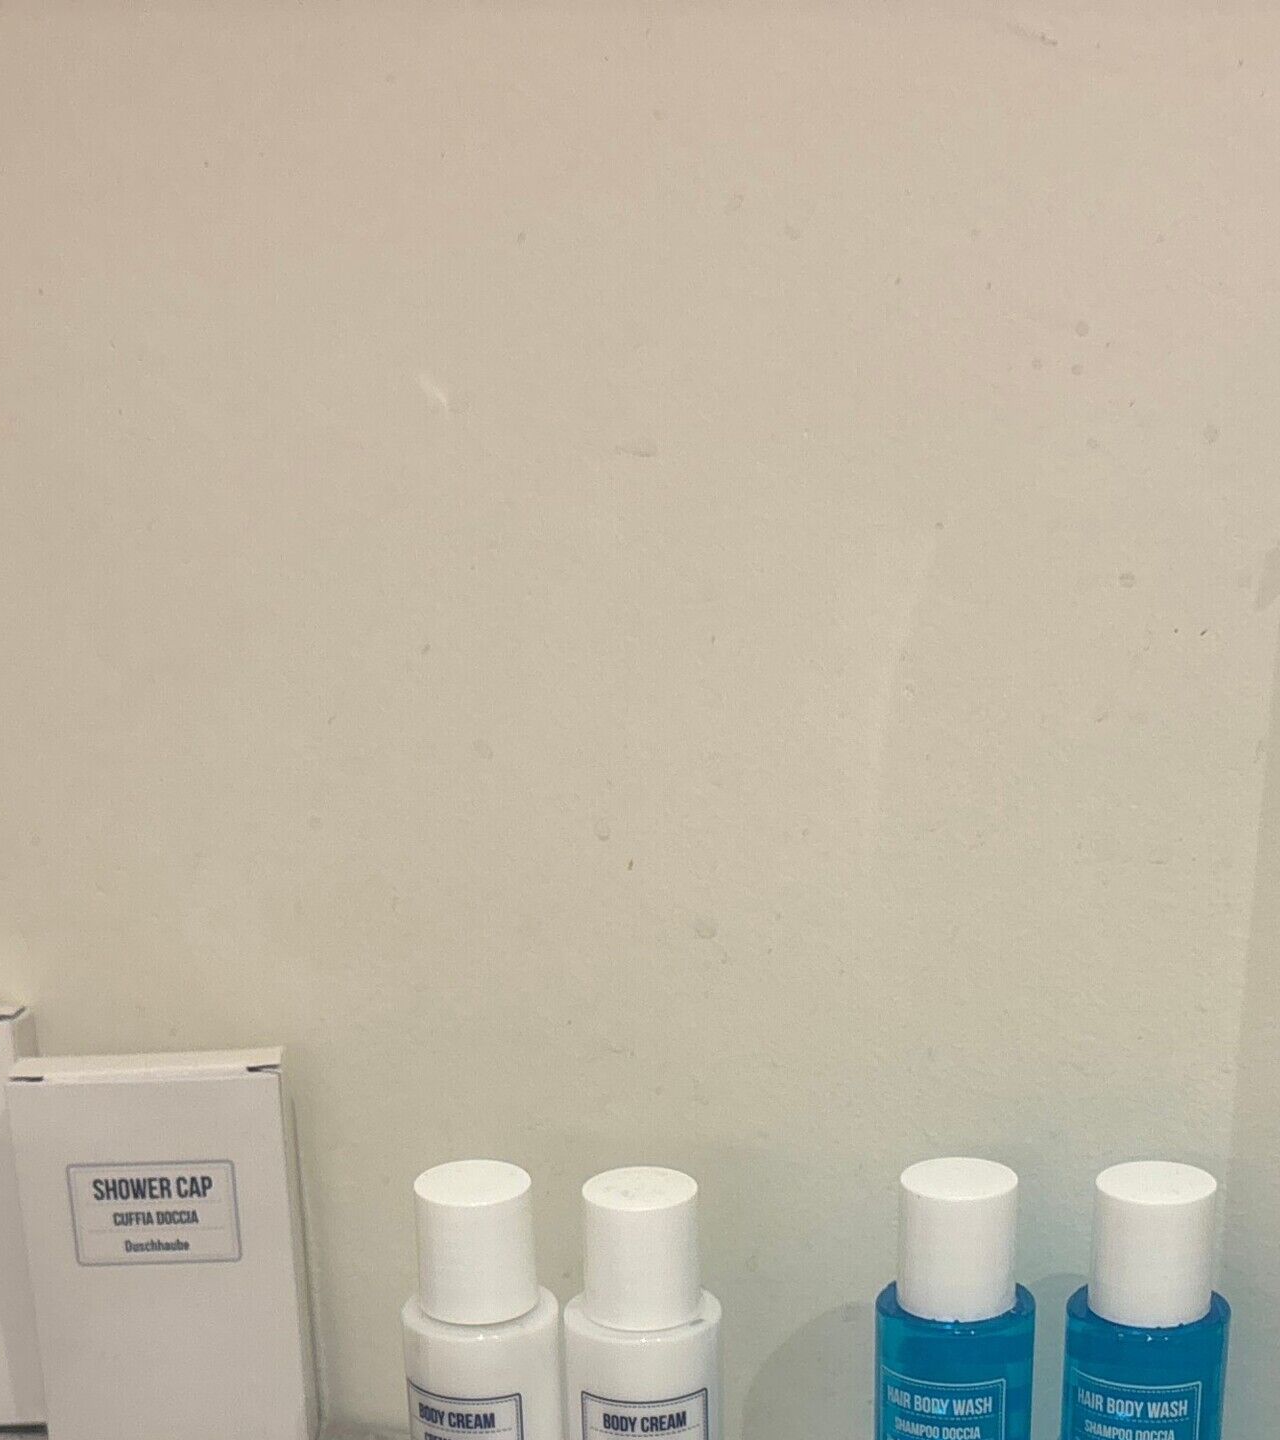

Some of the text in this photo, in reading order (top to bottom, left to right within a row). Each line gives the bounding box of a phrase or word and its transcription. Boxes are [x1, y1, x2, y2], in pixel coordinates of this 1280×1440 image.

[92, 1175, 213, 1201] SHOWER CAP
[113, 1210, 199, 1227] CUFFIA DOCCIA
[124, 1239, 190, 1254] Duschhaube
[887, 1385, 993, 1416] HAIR BODY WASH
[1077, 1387, 1188, 1419] HAIR BODY WASH
[418, 1402, 496, 1429] BODY CREAM
[603, 1411, 687, 1433] BODY CREAM
[895, 1417, 981, 1440] SHAMPOO DOCCIA
